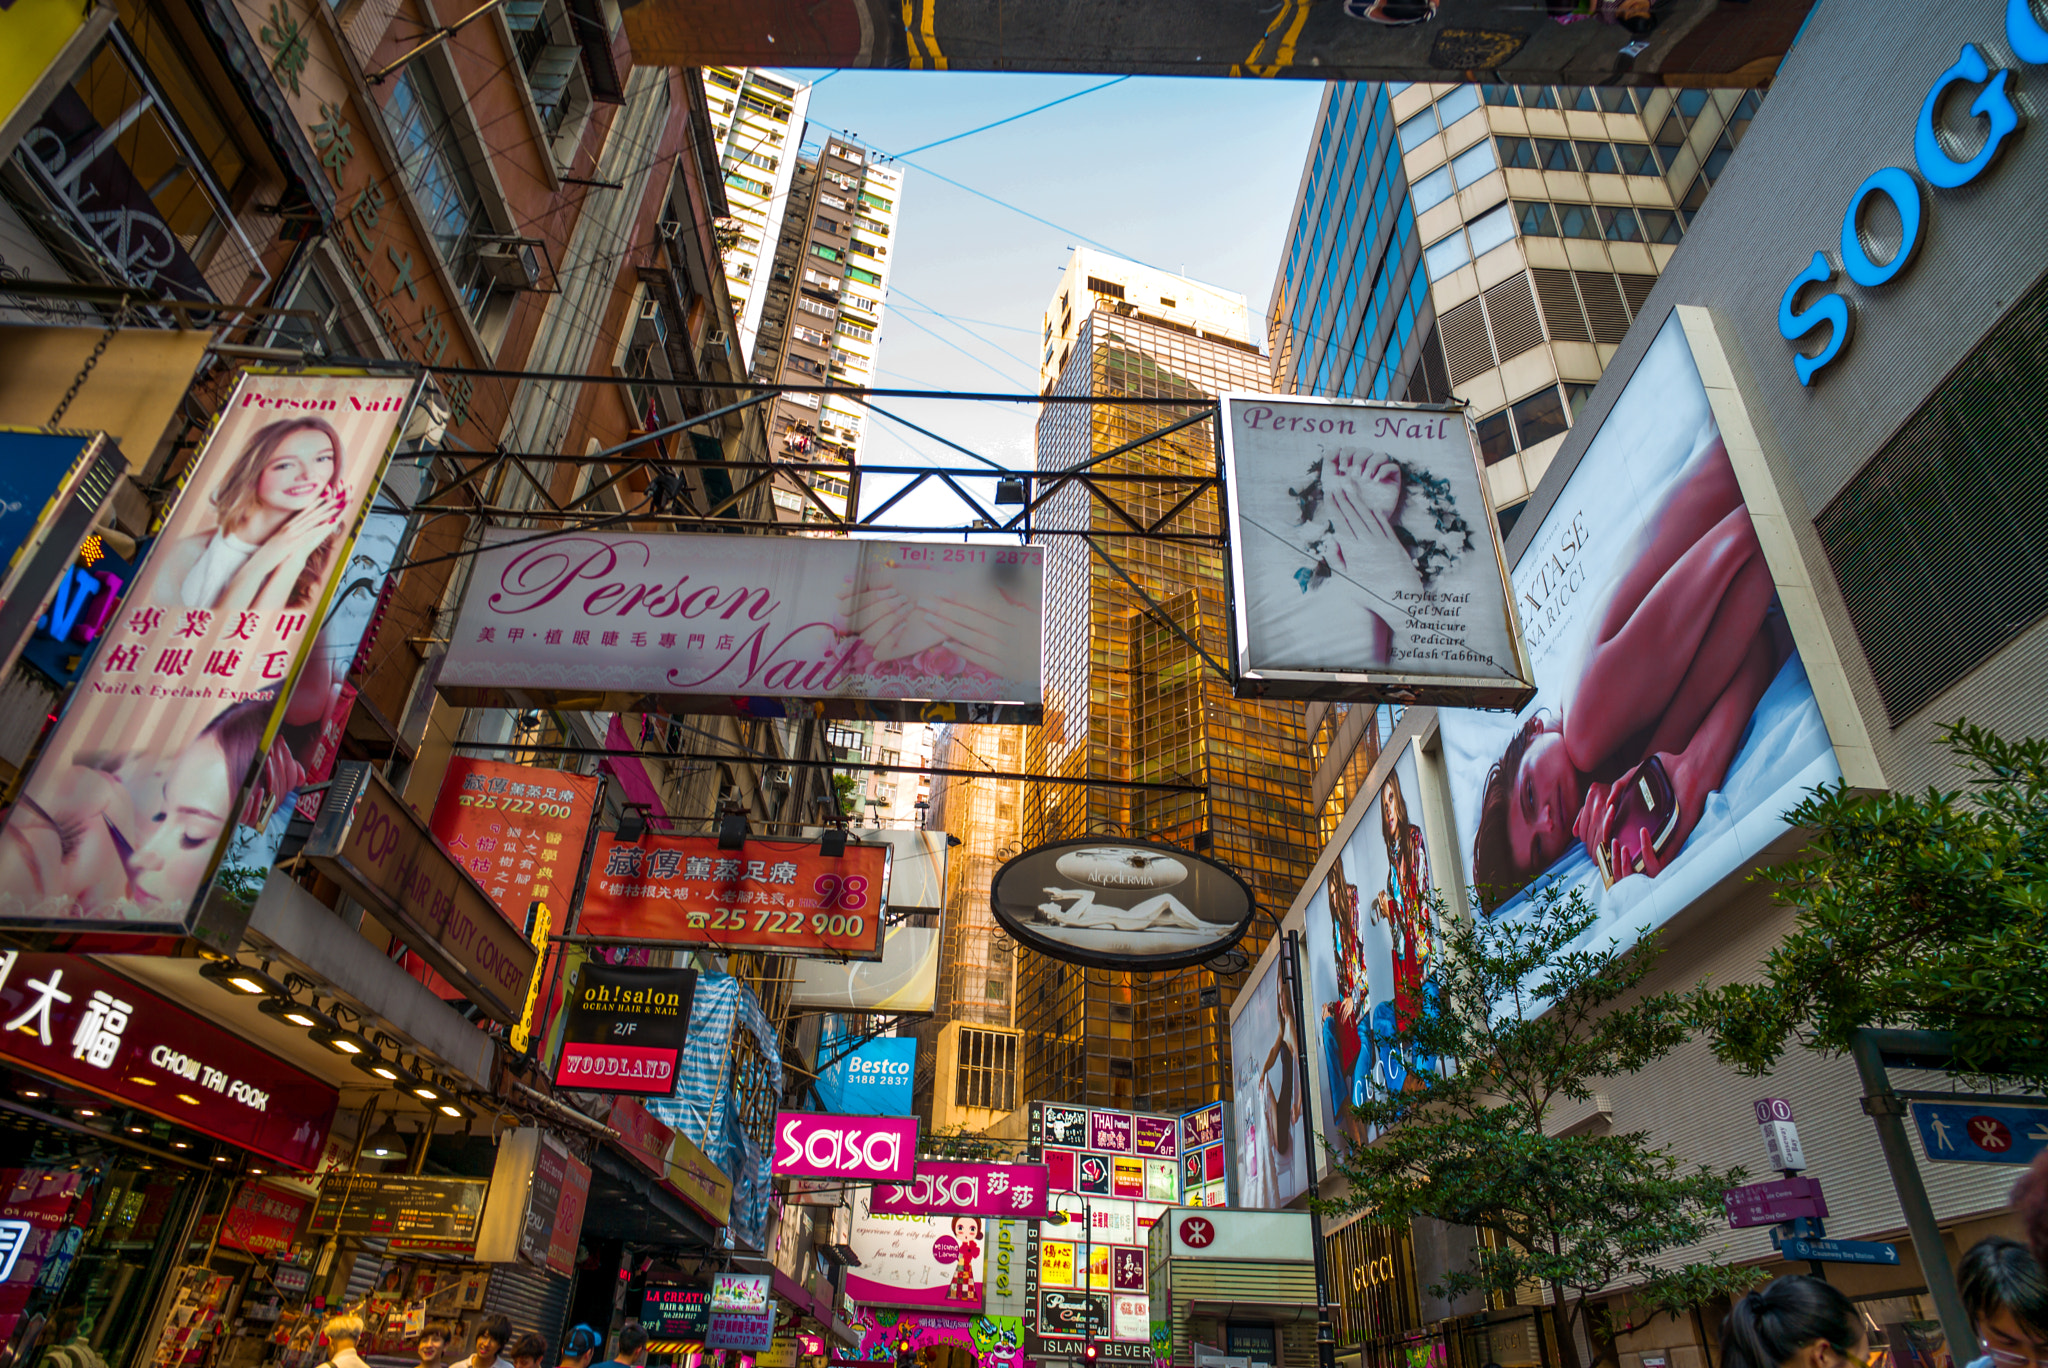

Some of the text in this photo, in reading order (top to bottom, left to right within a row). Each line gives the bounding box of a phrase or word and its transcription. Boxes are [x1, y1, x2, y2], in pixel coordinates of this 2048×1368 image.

[241, 393, 403, 412] Person Nail
[1243, 406, 1450, 441] Person Nail
[900, 547, 1043, 565] Tel: 2511 2873
[1392, 590, 1470, 604] Acrylic Nail
[1546, 561, 1586, 628] RICCI
[488, 537, 864, 692] Person Nail
[1407, 605, 1461, 618] Gel Nail
[124, 606, 308, 641] 專業美甲
[1405, 619, 1466, 632] Manicure
[1410, 634, 1465, 646] Pedicure
[103, 643, 288, 679] 植眼睫毛
[1389, 647, 1493, 666] Eyelash Tabbing
[90, 681, 275, 703] Nail & Eyelash Expert
[474, 794, 571, 819] 25 722 900
[355, 801, 524, 996] POP HAIR BEAUTY CONCEPT
[813, 872, 869, 911] 98
[710, 908, 865, 938] 25 722 900
[584, 985, 679, 1007] oh!salon
[583, 1002, 678, 1016] OCEAN HAIR & NAIL
[614, 1022, 637, 1036] 2/F
[567, 1055, 671, 1079] WOODLAND
[848, 1056, 910, 1075] Bestco
[150, 1044, 270, 1112] CHOW TAI FOOK
[848, 1075, 908, 1085] 3188 2837
[1094, 1113, 1114, 1131] THAI
[1160, 1145, 1175, 1157] 8/F
[1780, 1127, 1794, 1163] Causeway
[1791, 1138, 1799, 1153] Bay
[987, 1171, 1034, 1210] 莎莎
[997, 1219, 1015, 1298] Laforet
[1025, 1228, 1038, 1333] BEVERLEY
[1353, 1254, 1395, 1292] GUCCI
[646, 1290, 660, 1302] LA
[660, 1302, 677, 1311] HAIR
[686, 1304, 702, 1312] NAIL
[642, 1321, 656, 1330] 2/F
[937, 1333, 972, 1349] Laforet
[1043, 1340, 1087, 1354] ISLAN
